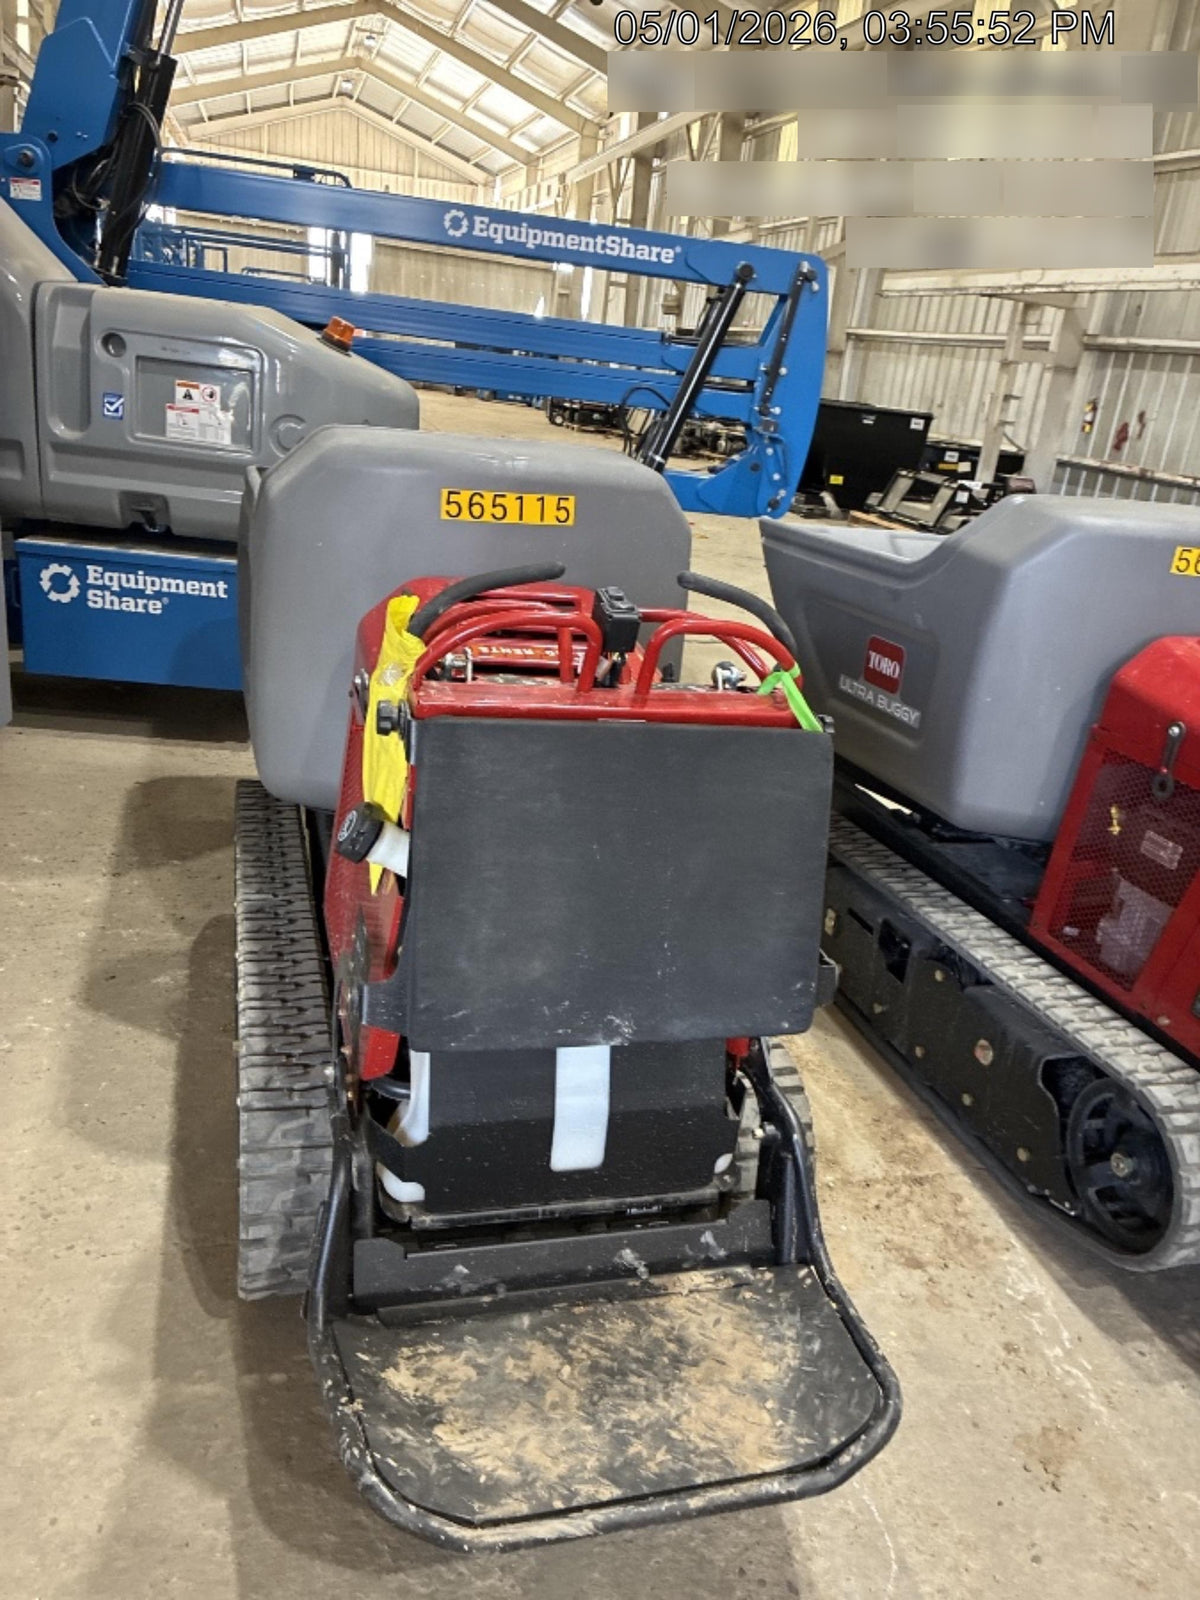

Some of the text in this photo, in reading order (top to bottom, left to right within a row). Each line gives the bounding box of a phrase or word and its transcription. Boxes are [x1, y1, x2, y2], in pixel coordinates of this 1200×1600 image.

[472, 215, 676, 264] EquipmentShare
[445, 490, 570, 523] 565115
[86, 565, 228, 598] Equipment
[86, 590, 163, 614] Share
[868, 650, 900, 679] TORO
[839, 674, 920, 726] ULTRA BUGGY
